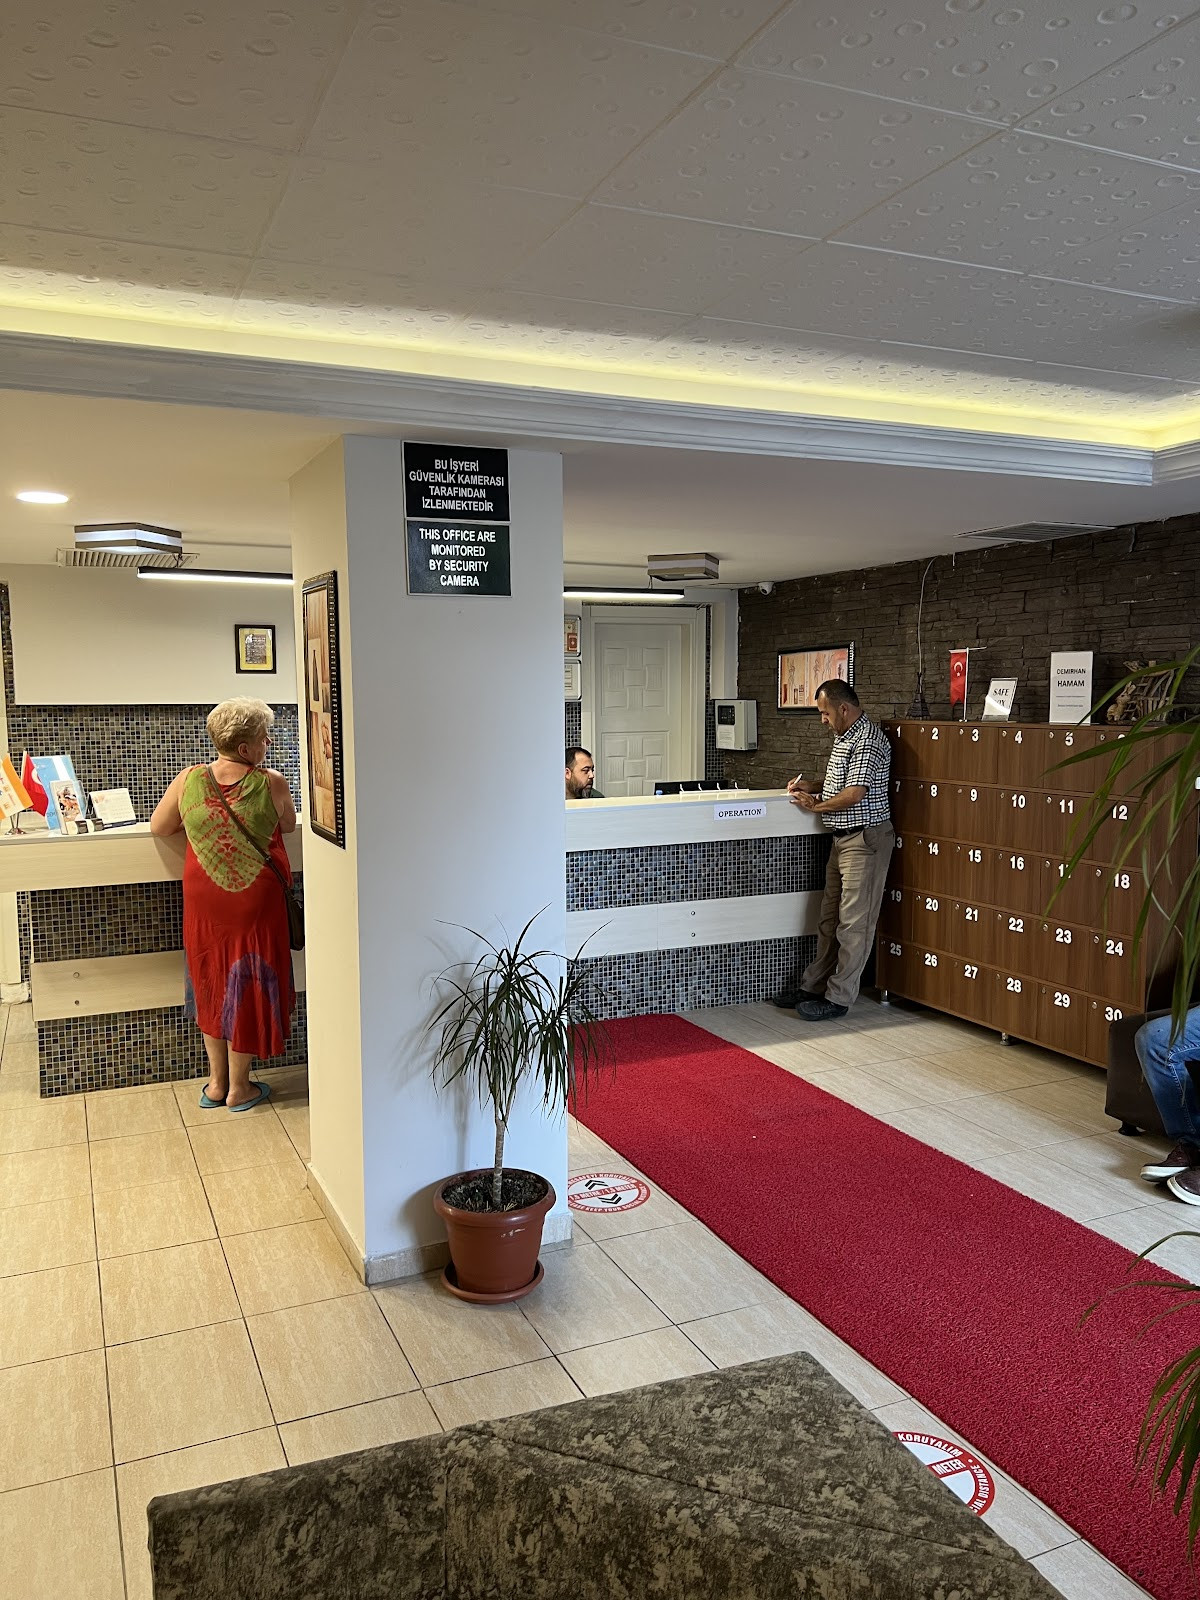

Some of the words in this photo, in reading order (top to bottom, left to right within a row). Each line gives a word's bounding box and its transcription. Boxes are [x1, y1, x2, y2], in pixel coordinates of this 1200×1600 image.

[435, 459, 447, 470] BU
[450, 458, 479, 472] İŞYERİ
[409, 470, 456, 484] GÜVENLİK
[458, 474, 504, 486] KAMERASI
[429, 486, 486, 498] TARAFINDAN
[422, 497, 493, 512] İZLENMEKTEDİR
[419, 528, 440, 540] THIS
[443, 529, 475, 542] OFFICE
[477, 531, 496, 542] ARE
[431, 544, 486, 556] MONITORED
[429, 559, 442, 571] BY
[444, 560, 488, 572] SECURITY
[440, 575, 480, 587] CAMERA
[993, 688, 1009, 696] SAFE
[896, 726, 901, 738] 1
[931, 727, 938, 740] 2
[972, 728, 979, 742] 3
[1014, 730, 1023, 744] 4
[1065, 732, 1074, 746] 5
[895, 781, 900, 792] 7
[931, 784, 938, 797] 8
[970, 788, 977, 801] 9
[1011, 794, 1026, 808] 10
[718, 809, 761, 817] OPERATION
[1060, 799, 1074, 814] 11
[1112, 805, 1128, 820] 12
[896, 837, 903, 848] 3
[928, 842, 939, 855] 14
[968, 849, 982, 862] 15
[1010, 855, 1025, 870] 16
[1114, 873, 1130, 889] 18
[891, 890, 901, 902] 19
[926, 898, 938, 911] 20
[965, 907, 978, 921] 21
[1008, 917, 1024, 933] 22
[1055, 928, 1072, 944] 23
[890, 943, 902, 956] 25
[1105, 940, 1123, 956] 24
[924, 953, 938, 967] 26
[964, 965, 978, 979] 27
[1007, 977, 1022, 993] 28
[1054, 992, 1070, 1008] 29
[1105, 1006, 1122, 1021] 30
[898, 1433, 964, 1457] KORUYALIM
[932, 1458, 966, 1475] METER
[970, 1464, 990, 1498] DISTANCE
